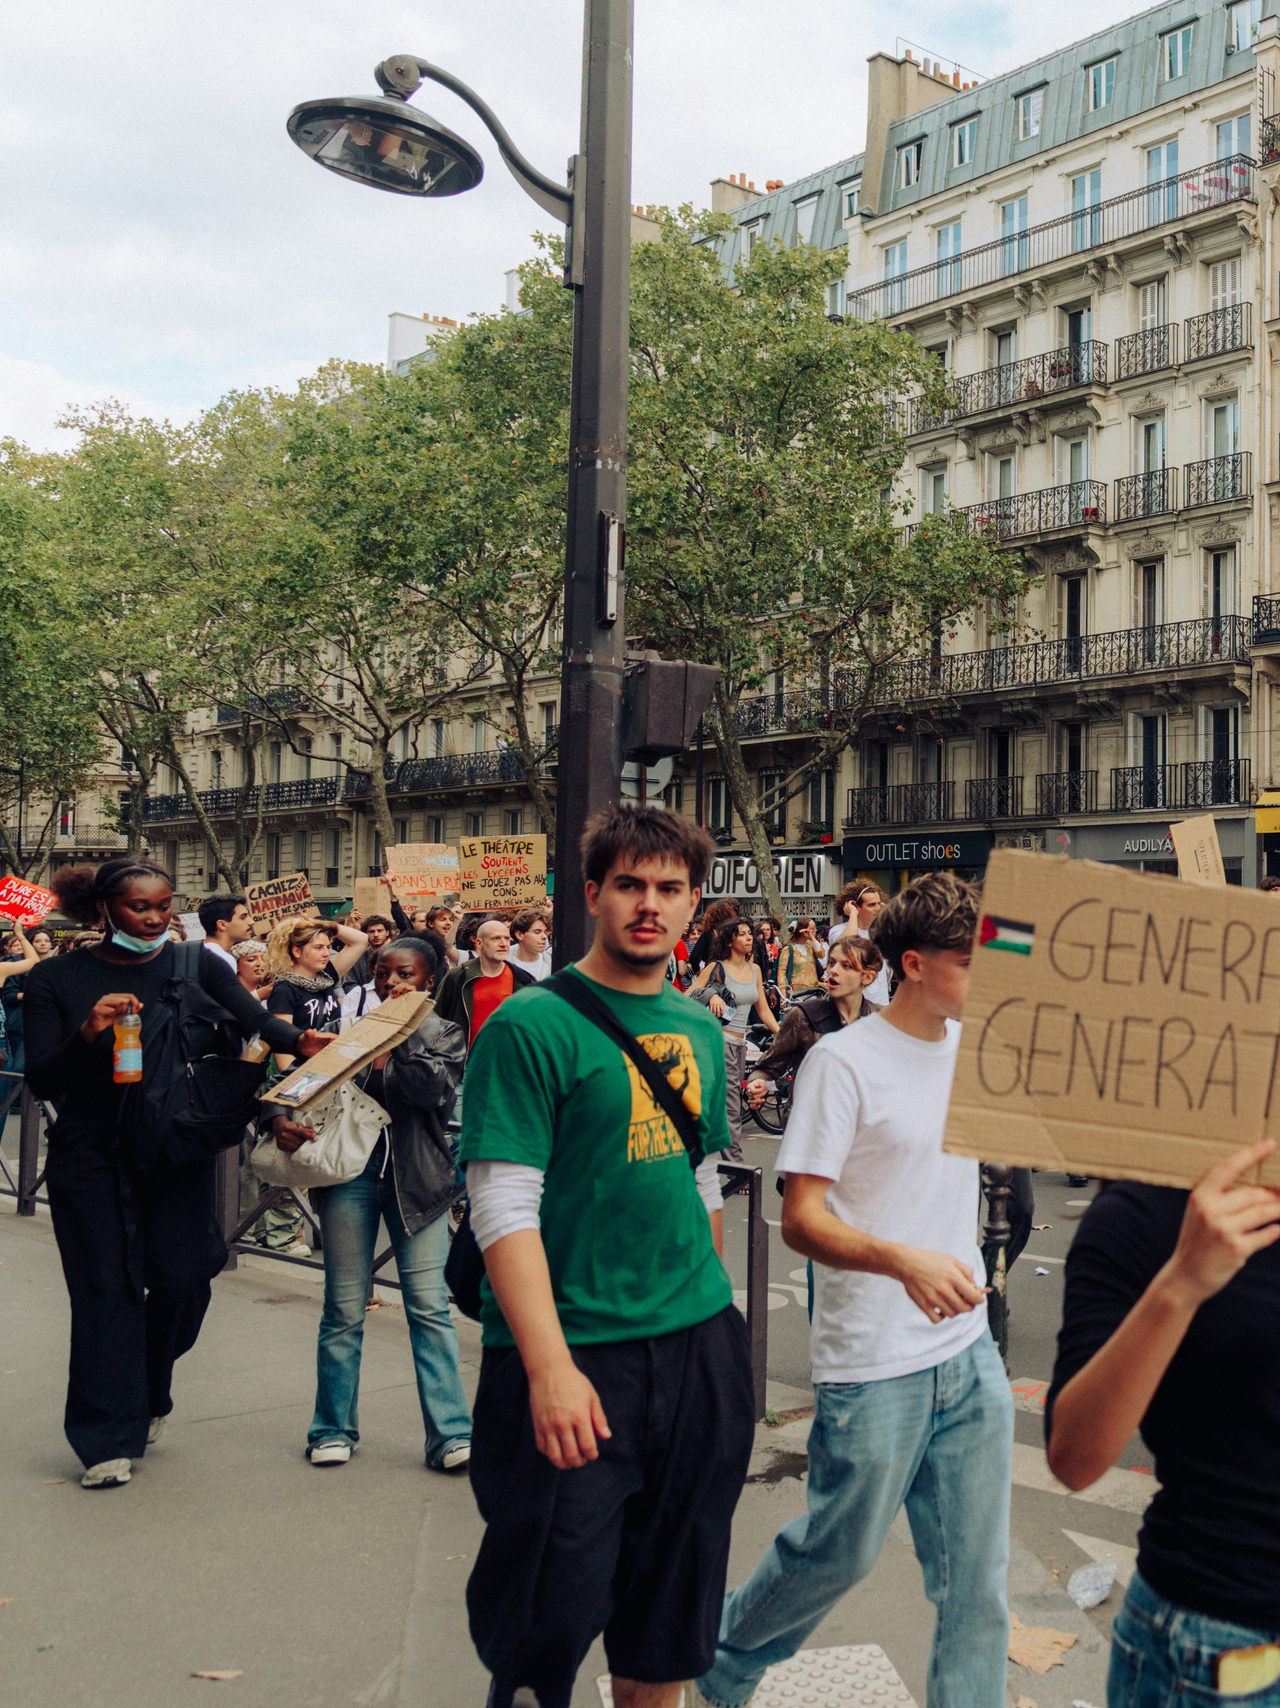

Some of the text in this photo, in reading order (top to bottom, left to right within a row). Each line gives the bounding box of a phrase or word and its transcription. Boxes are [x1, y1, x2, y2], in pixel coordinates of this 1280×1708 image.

[462, 839, 534, 858] LE THÉÂTRE
[866, 841, 961, 861] OUTLET shoes
[1123, 839, 1172, 852] AUDILYA
[463, 864, 528, 879] LES LYCÉENS
[5, 880, 35, 897] DURE
[248, 878, 299, 901] CACHEZ
[394, 875, 427, 889] DANS
[430, 876, 442, 888] LA
[462, 881, 476, 890] NE
[480, 878, 509, 888] JOUEZ
[514, 875, 531, 886] PAS
[250, 882, 312, 914] MATRAQUE
[252, 913, 267, 923] QUE
